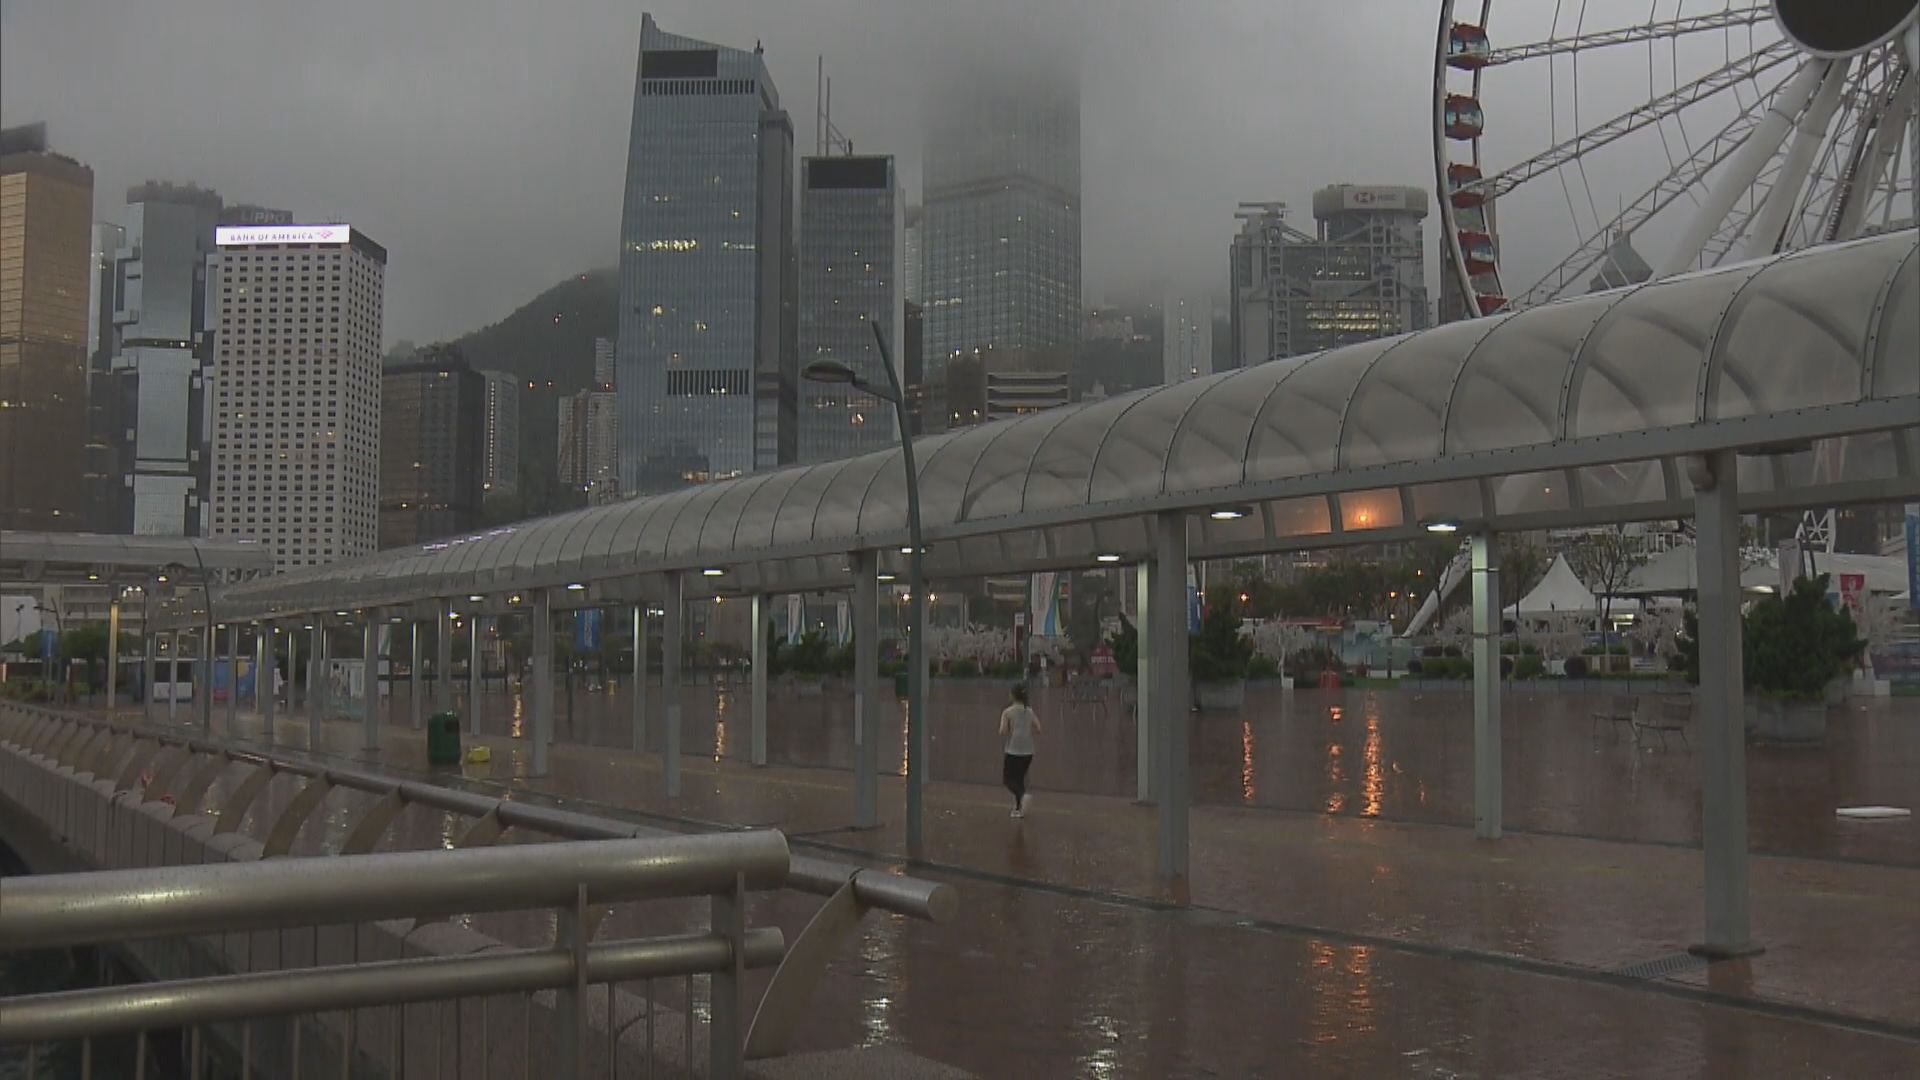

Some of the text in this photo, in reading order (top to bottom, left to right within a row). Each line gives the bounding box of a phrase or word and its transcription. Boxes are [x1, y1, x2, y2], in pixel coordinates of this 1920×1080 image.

[230, 231, 313, 242] BANK OF AMERICA
